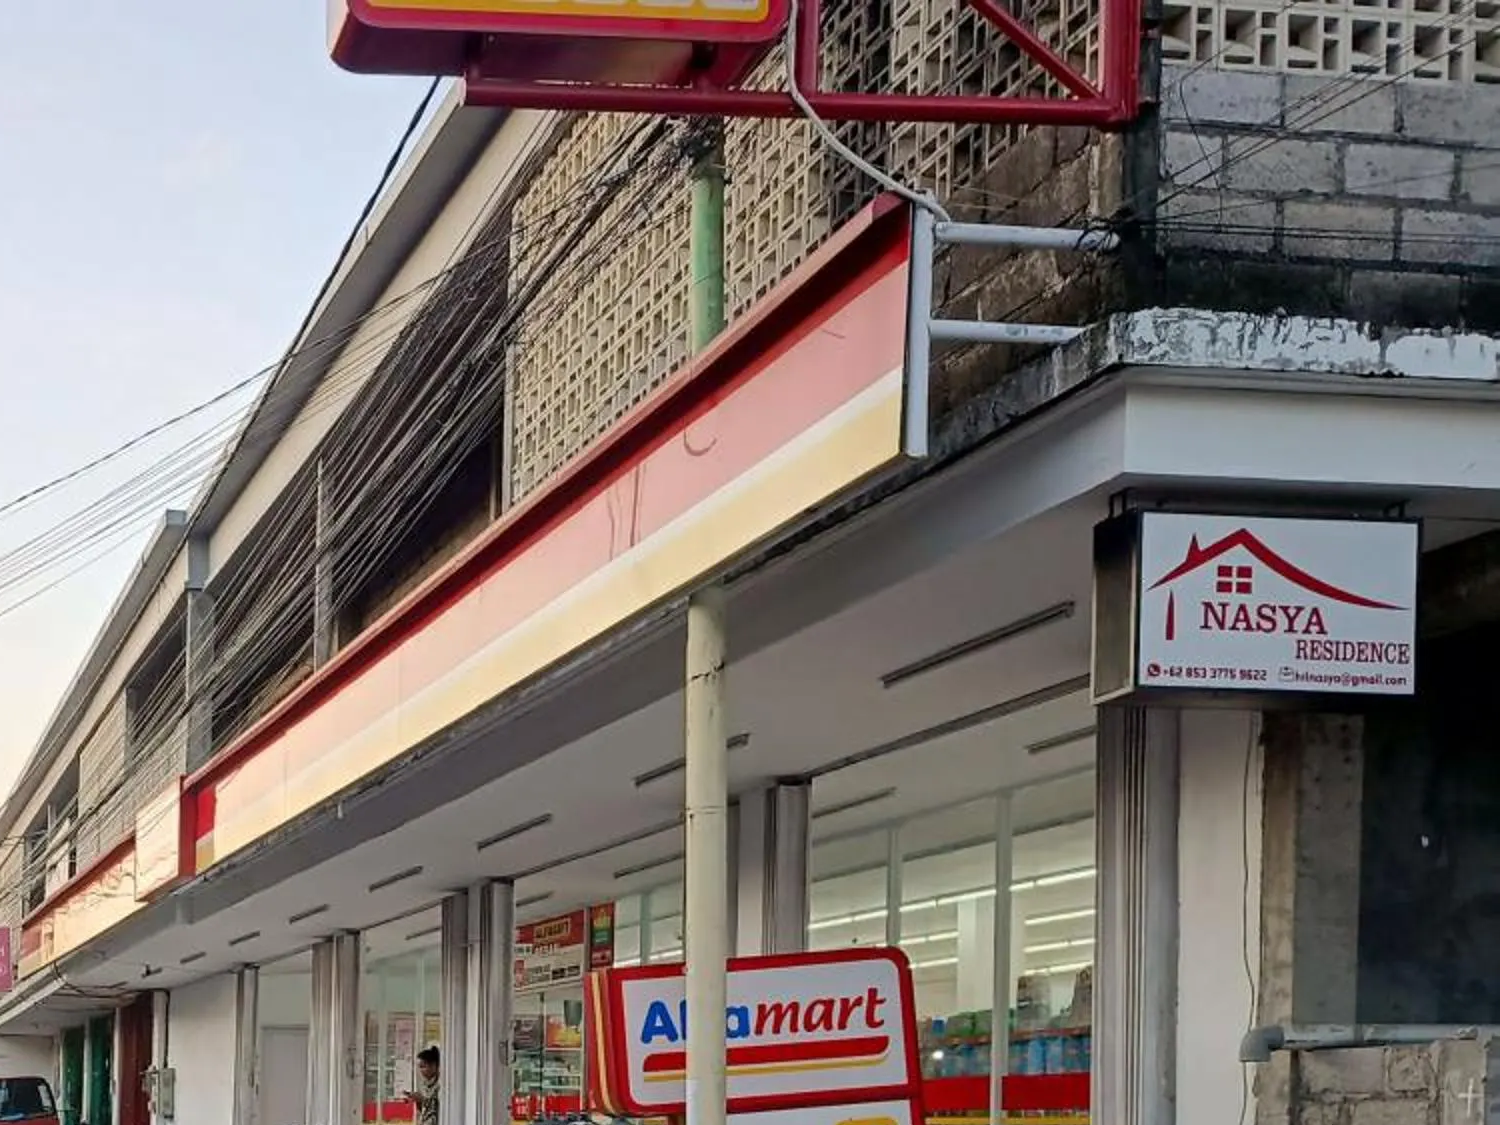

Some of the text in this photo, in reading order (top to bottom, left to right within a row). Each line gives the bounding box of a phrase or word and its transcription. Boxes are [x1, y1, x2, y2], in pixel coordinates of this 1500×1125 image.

[1200, 601, 1328, 635] NASYA
[1295, 640, 1410, 665] RESIDENCE
[640, 987, 887, 1044] Alamart
